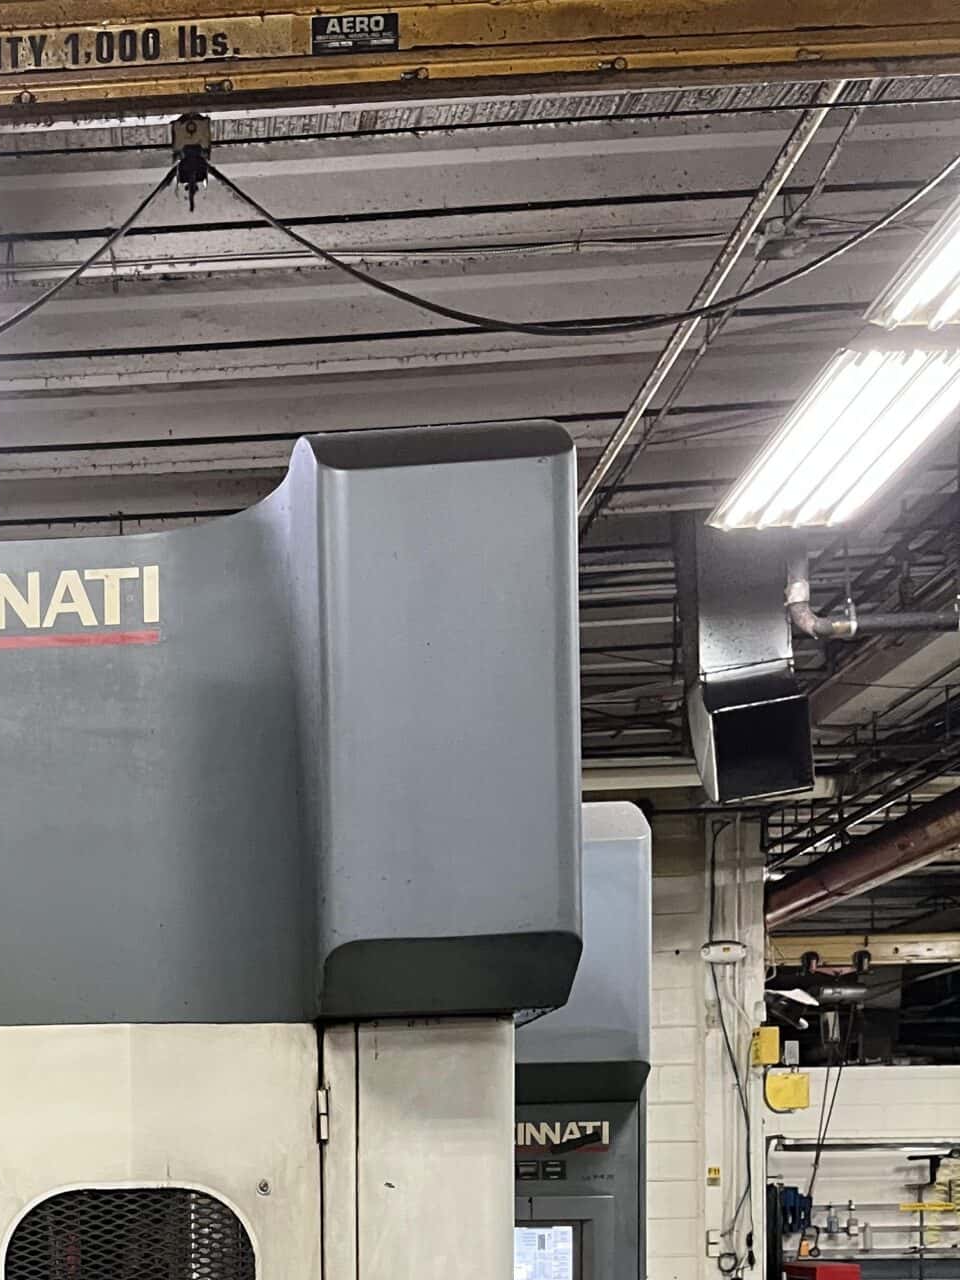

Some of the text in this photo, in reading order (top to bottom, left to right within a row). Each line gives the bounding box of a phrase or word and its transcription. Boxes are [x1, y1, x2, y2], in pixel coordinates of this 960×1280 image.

[326, 16, 385, 34] AERO
[64, 27, 161, 66] 1,000
[177, 25, 241, 59] lbs.
[515, 1121, 609, 1145] INNATI
